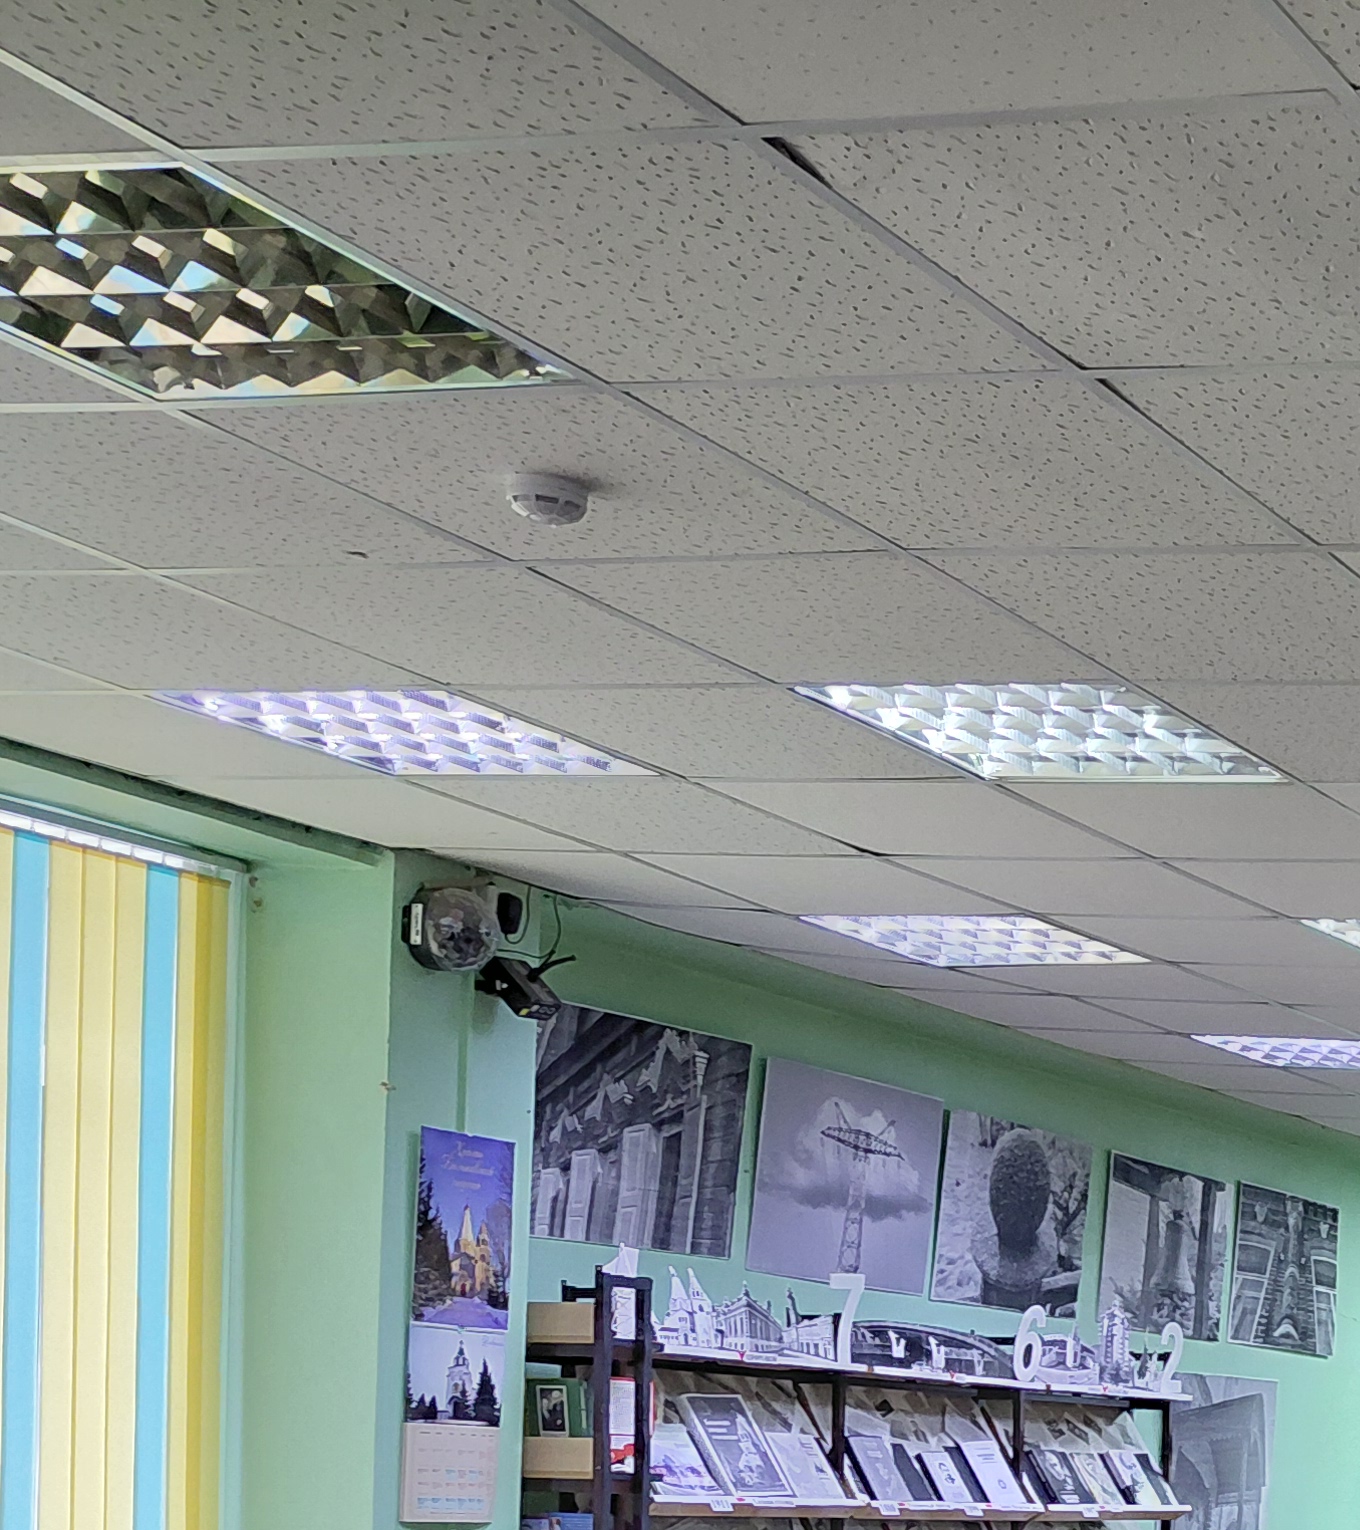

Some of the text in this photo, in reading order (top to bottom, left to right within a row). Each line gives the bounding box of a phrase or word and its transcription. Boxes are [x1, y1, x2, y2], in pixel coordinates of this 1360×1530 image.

[829, 1273, 1183, 1394] 7 6 2
